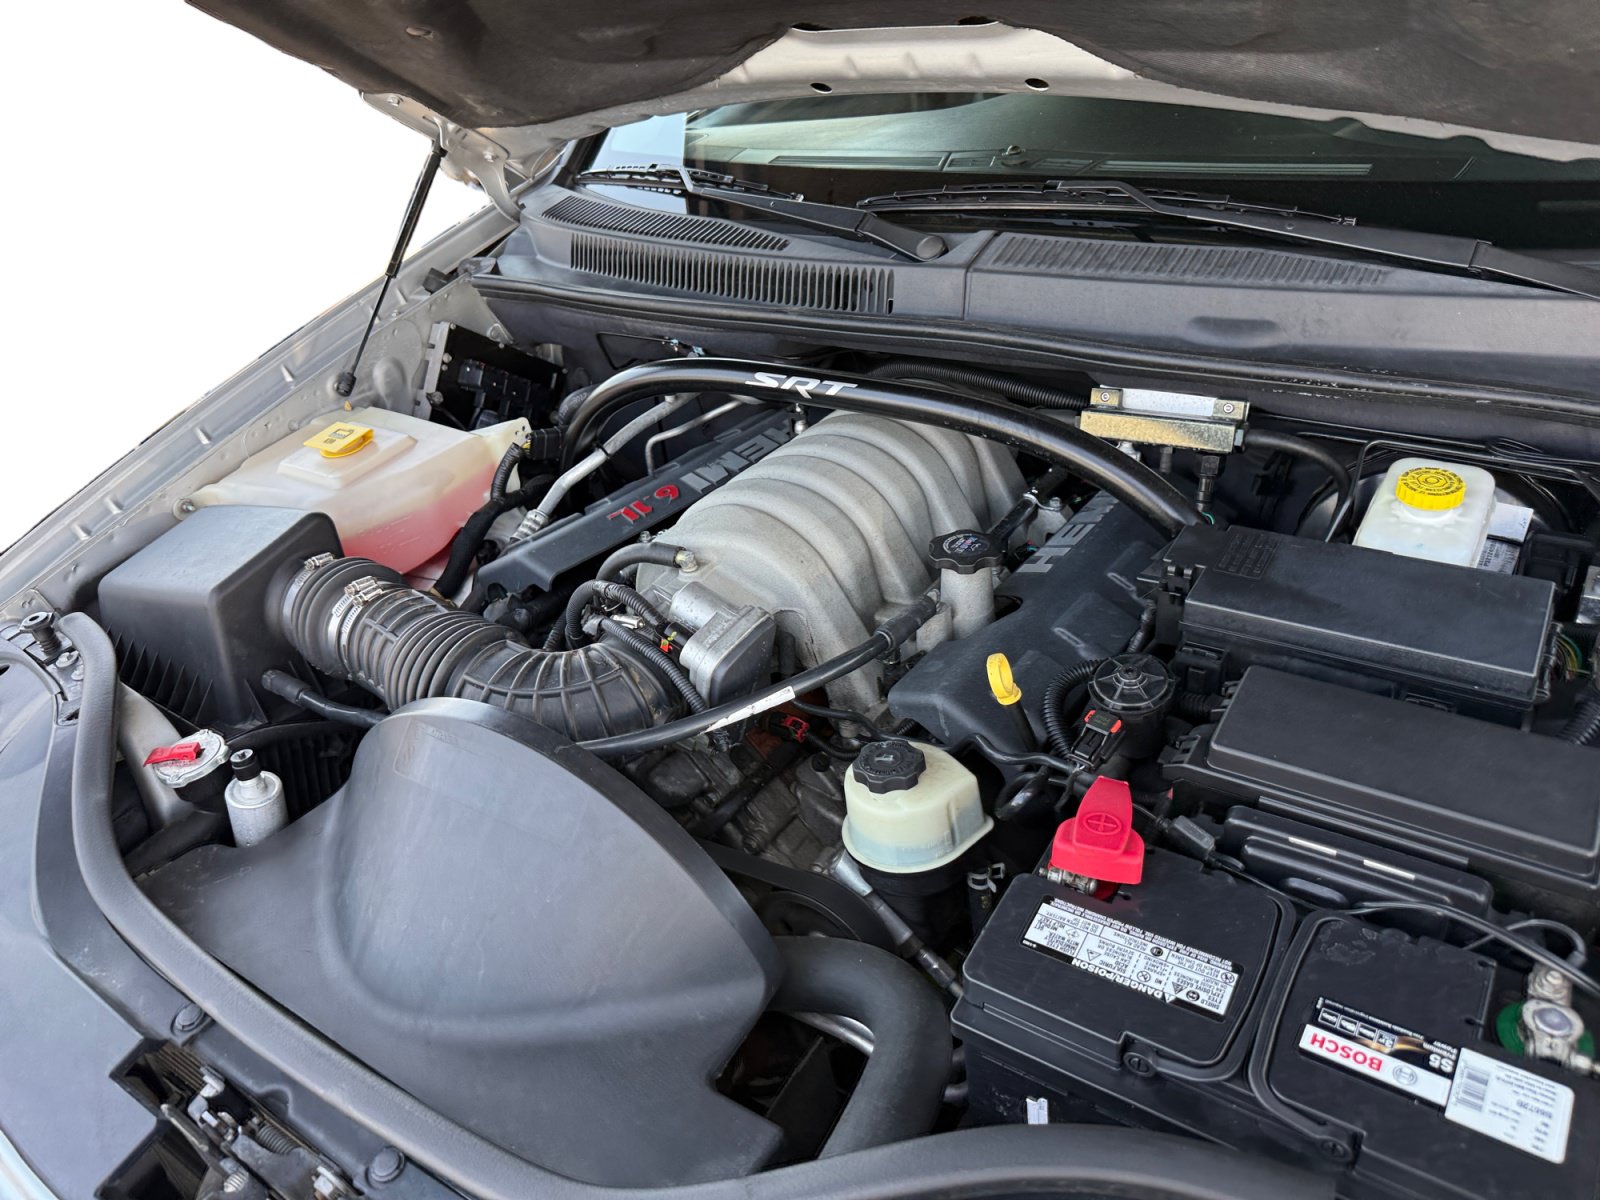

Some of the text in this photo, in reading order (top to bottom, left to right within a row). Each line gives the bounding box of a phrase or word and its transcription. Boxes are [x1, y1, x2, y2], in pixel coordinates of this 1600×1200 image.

[745, 371, 858, 399] SRT
[607, 484, 680, 525] 6.1L
[1098, 959, 1126, 974] SULFURIC
[1113, 959, 1128, 968] ACID
[1070, 957, 1163, 998] DANGER/POISON
[1200, 998, 1220, 1009] SHIELD
[1309, 1032, 1383, 1072] BOSCH
[1427, 1052, 1454, 1074] S5
